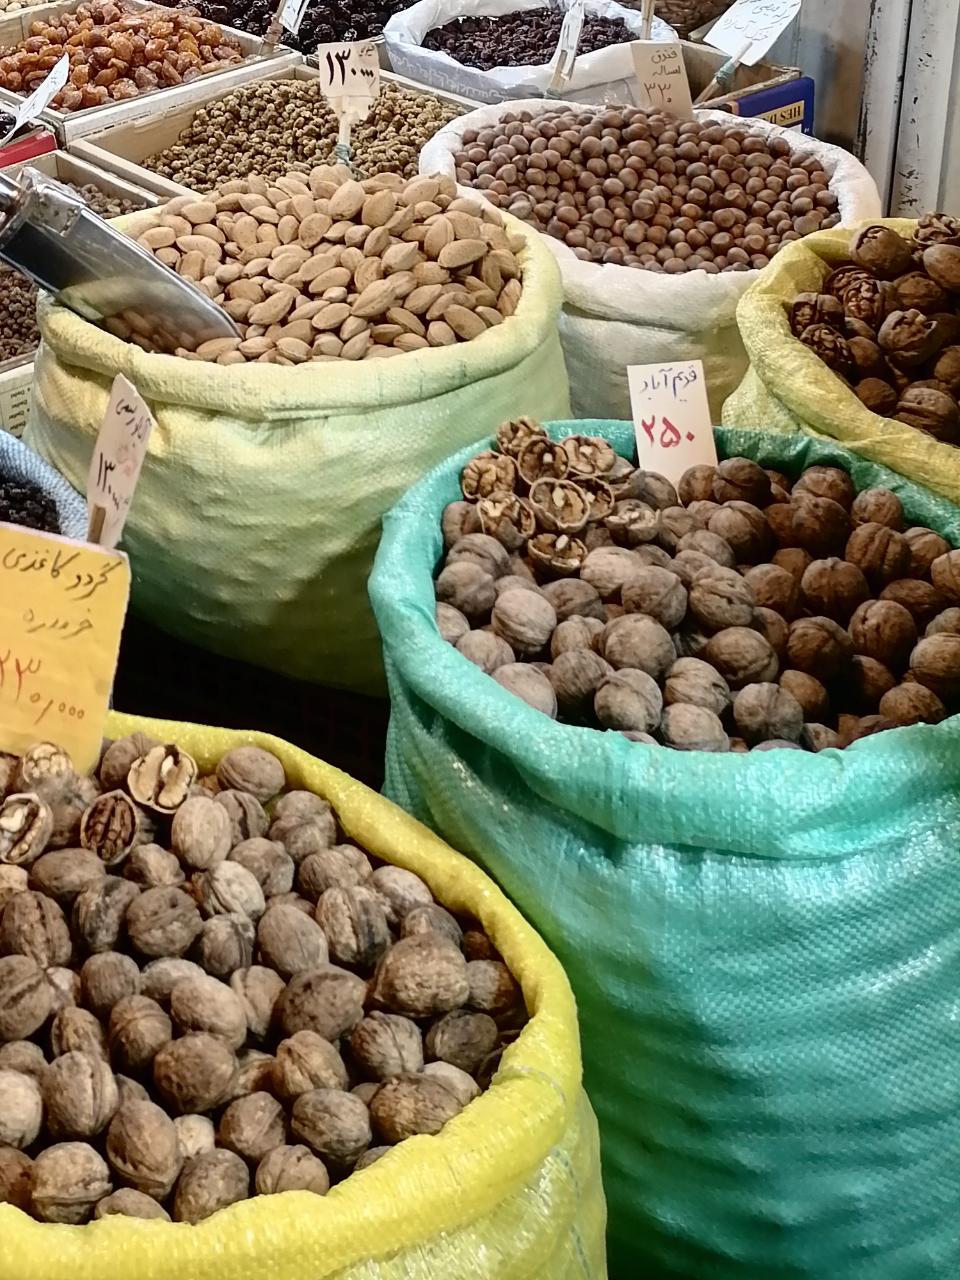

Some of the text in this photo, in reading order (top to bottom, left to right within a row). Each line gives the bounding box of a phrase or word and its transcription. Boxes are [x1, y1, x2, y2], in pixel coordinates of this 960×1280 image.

[650, 46, 678, 65] فندق
[641, 414, 695, 449] ۲۵۰
[65, 560, 123, 601] گردو
